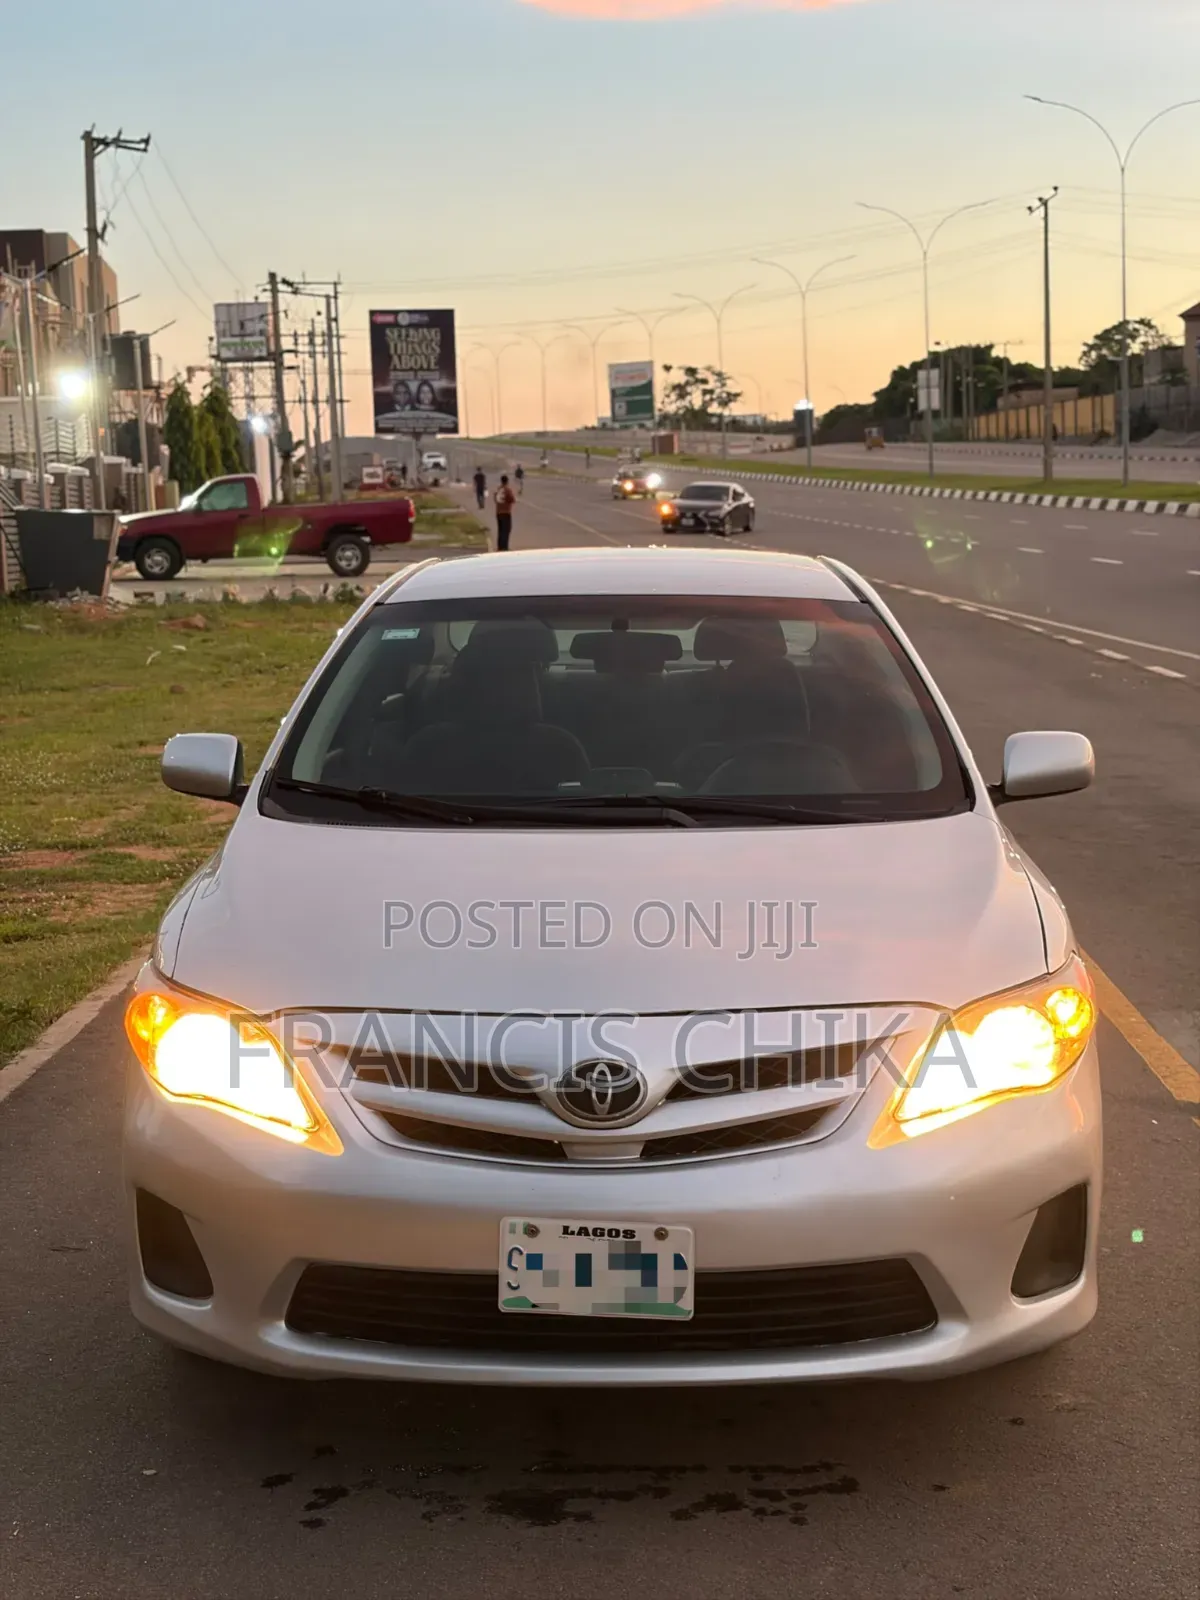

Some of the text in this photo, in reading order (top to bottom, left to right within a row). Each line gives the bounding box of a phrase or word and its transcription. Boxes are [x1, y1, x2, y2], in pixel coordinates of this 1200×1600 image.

[388, 341, 441, 356] THINGS
[389, 355, 440, 370] ABOVE
[562, 1225, 637, 1240] LAGOS
